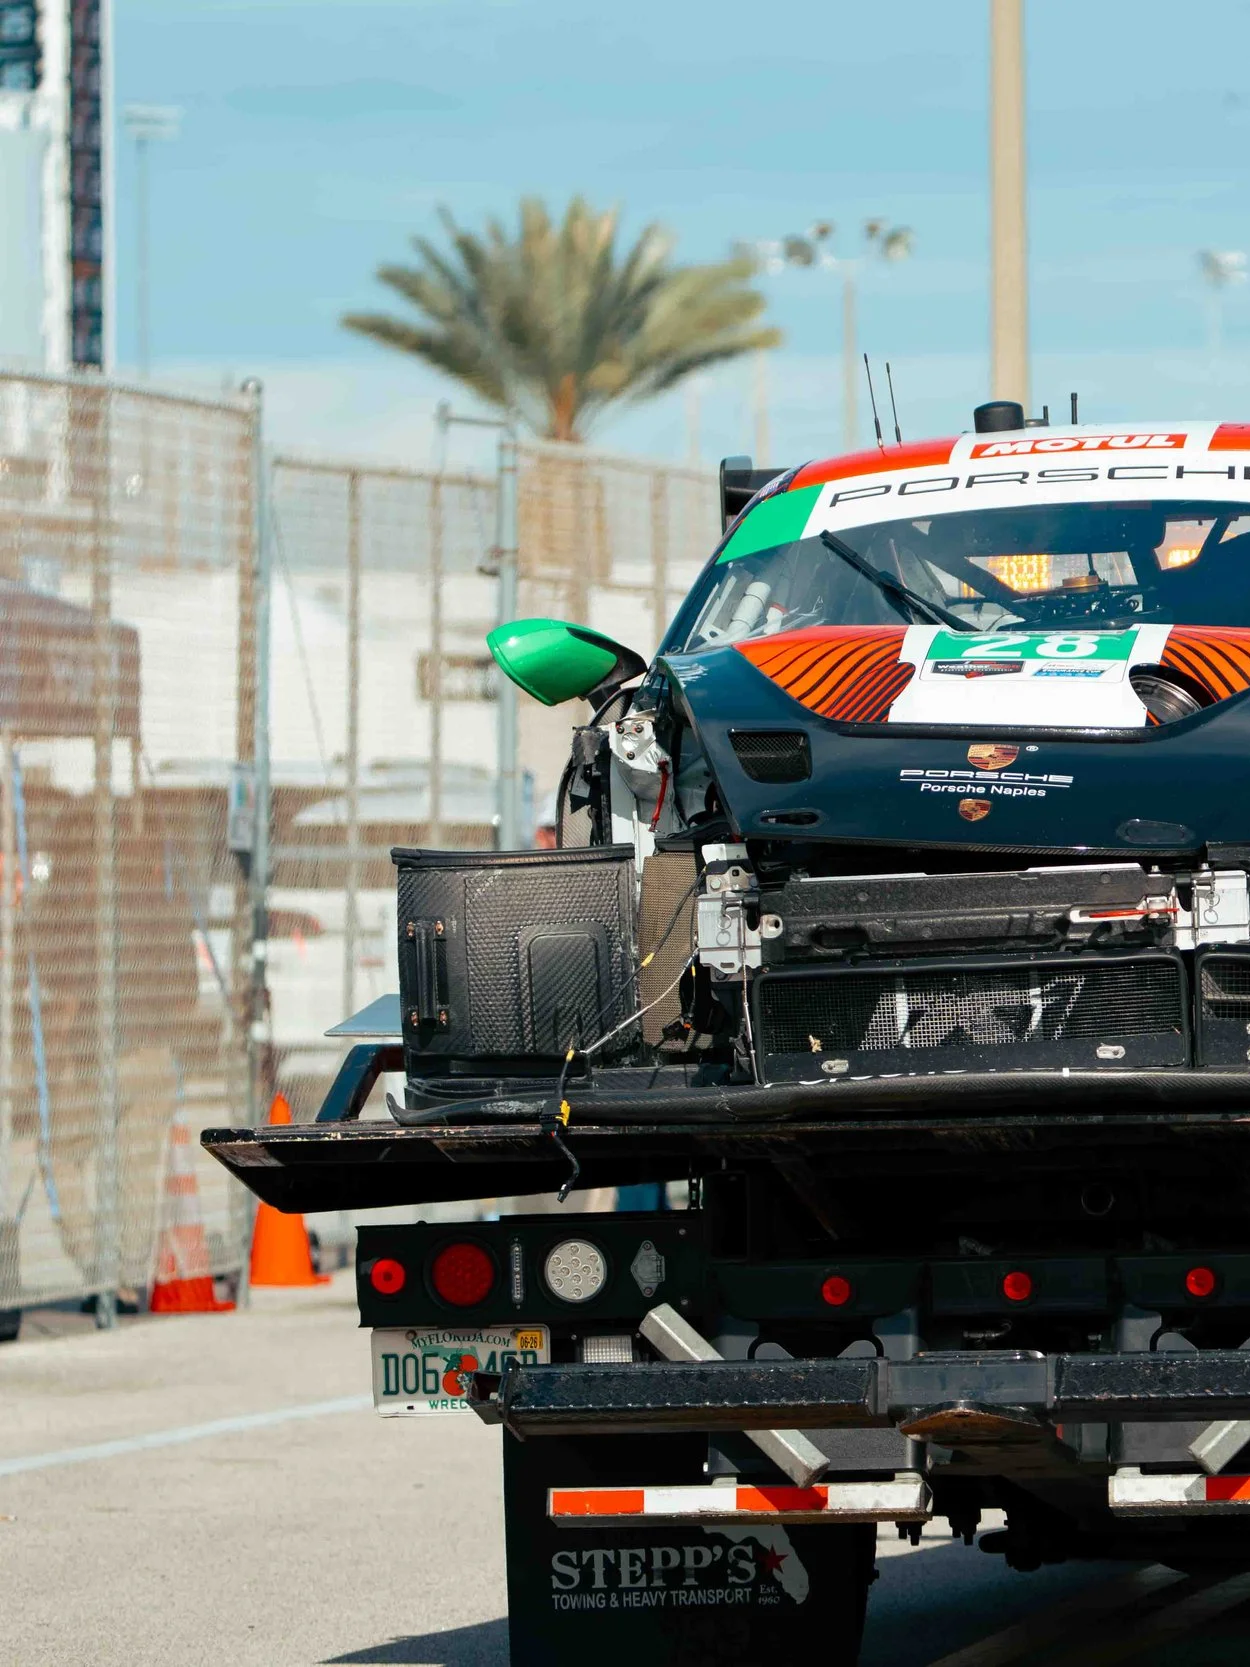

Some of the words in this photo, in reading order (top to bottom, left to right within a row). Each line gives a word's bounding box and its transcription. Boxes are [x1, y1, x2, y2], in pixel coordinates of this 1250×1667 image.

[979, 433, 1177, 457] MOTUL
[961, 633, 1100, 658] 28
[900, 769, 1074, 784] PORSCHE
[920, 783, 986, 794] Porsche
[990, 784, 1046, 797] Naples
[551, 1545, 756, 1590] STEPP'S
[552, 1593, 606, 1610] TOWING
[609, 1592, 620, 1608] &
[622, 1590, 668, 1607] HEAVY
[670, 1587, 752, 1605] TRANSPORT
[759, 1584, 777, 1595] Est.
